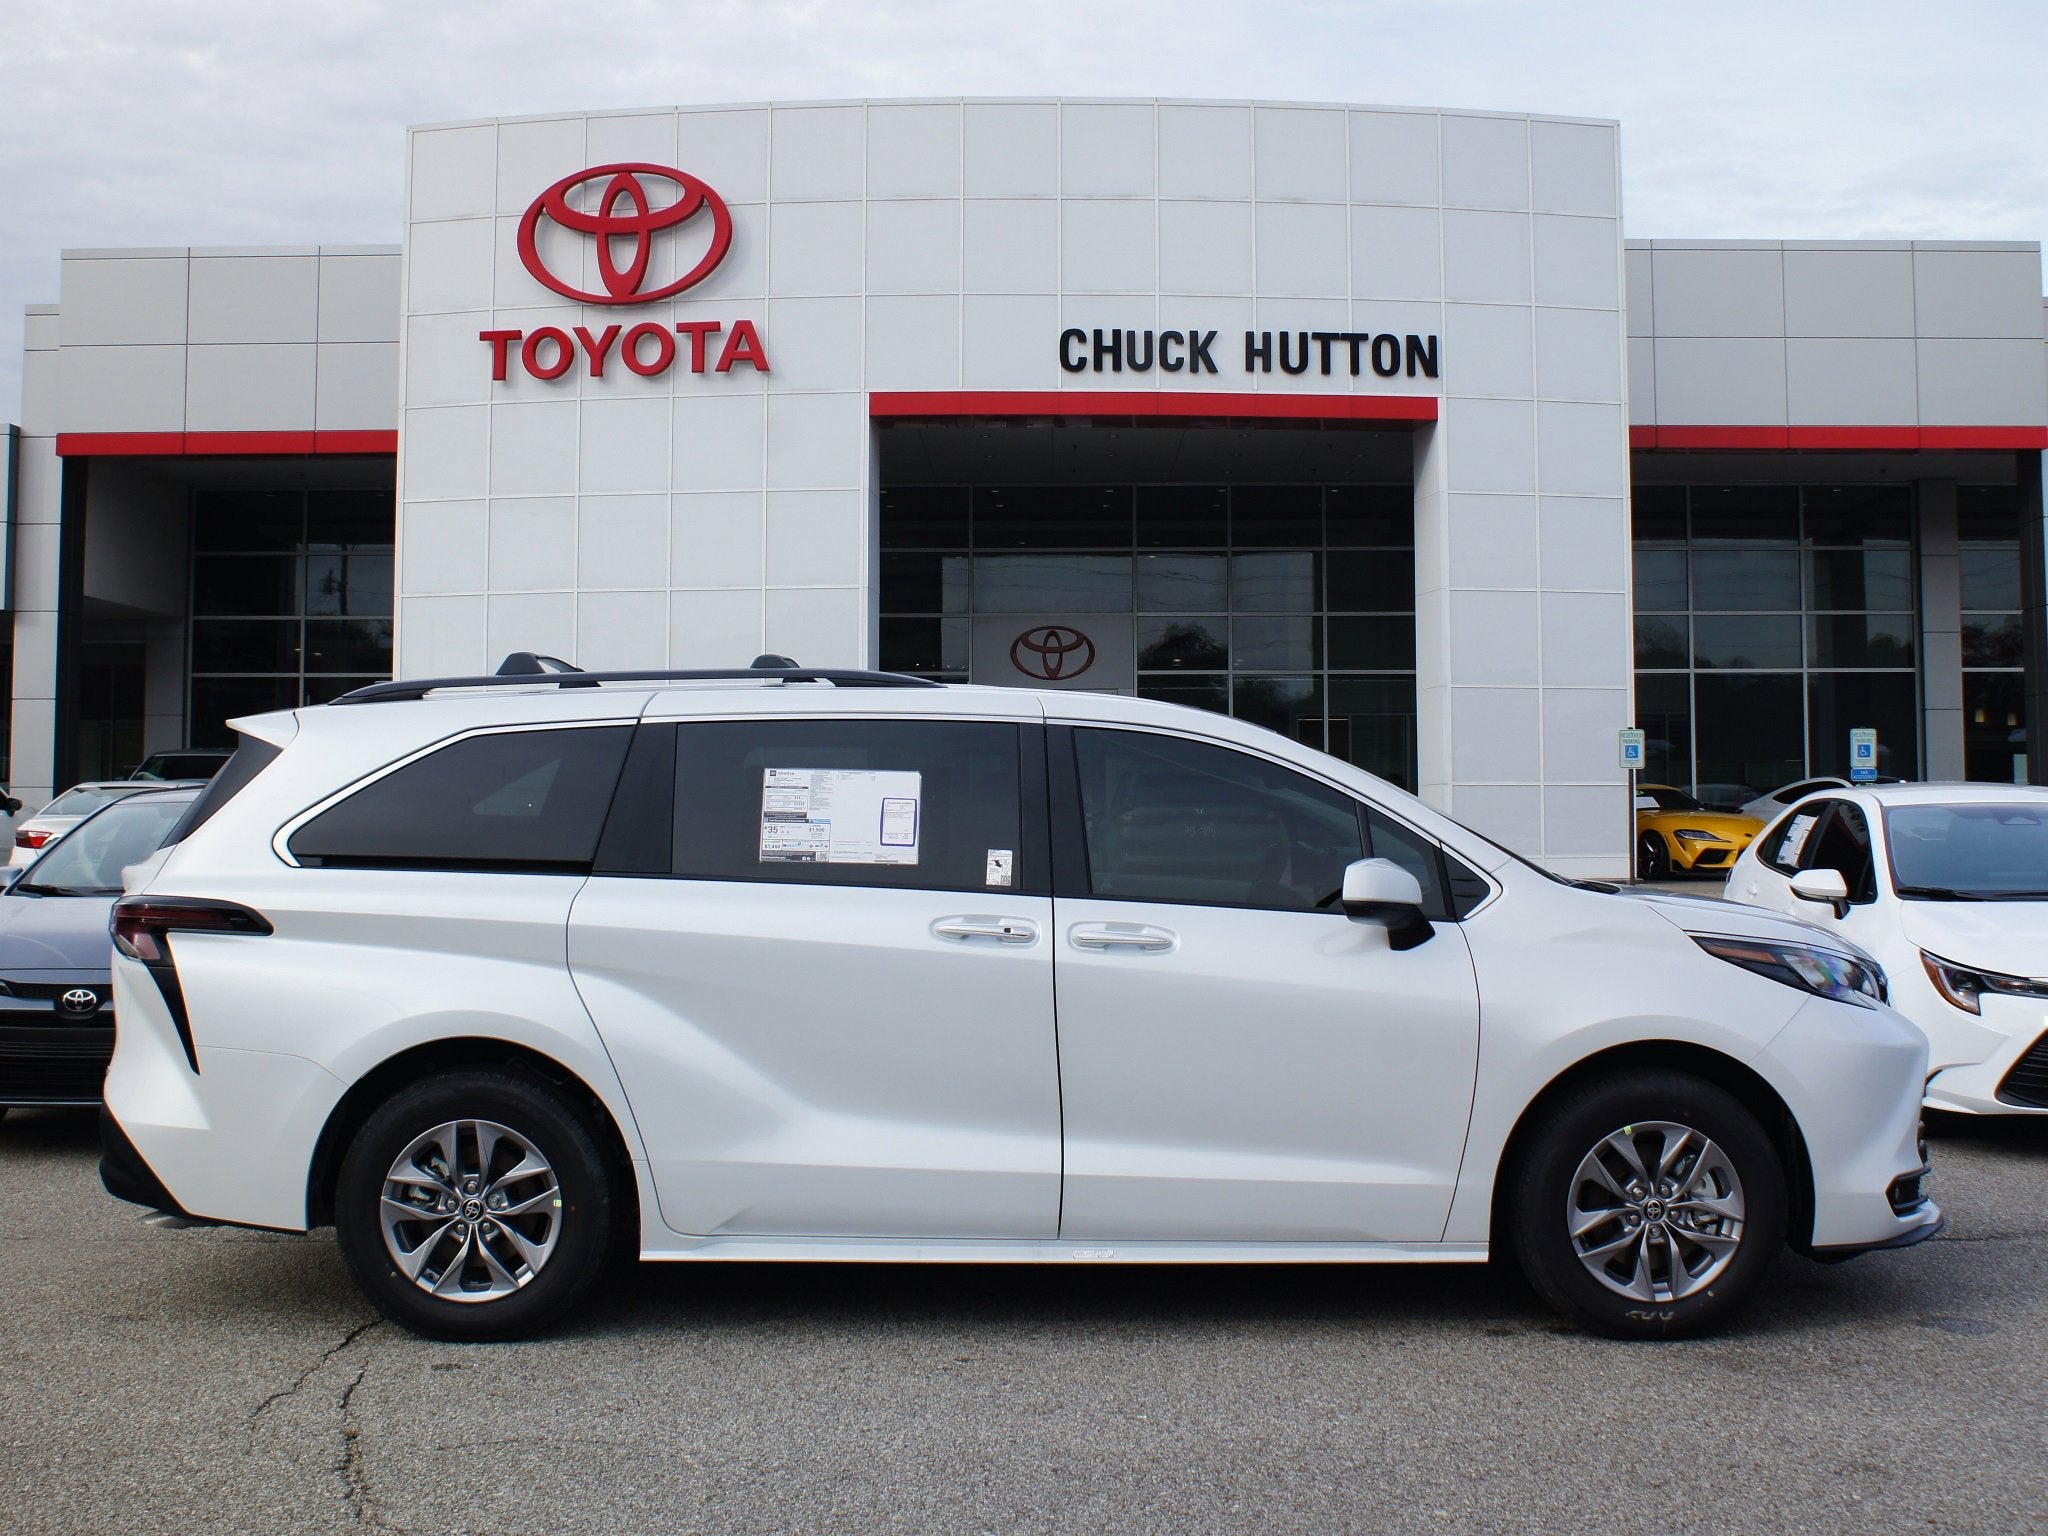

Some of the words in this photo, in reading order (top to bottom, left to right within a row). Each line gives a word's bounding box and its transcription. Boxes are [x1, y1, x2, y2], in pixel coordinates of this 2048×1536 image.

[479, 320, 770, 381] TOYOTA
[1059, 328, 1219, 374] CHUCK
[1245, 331, 1439, 378] HUTTON
[767, 825, 779, 834] 35
